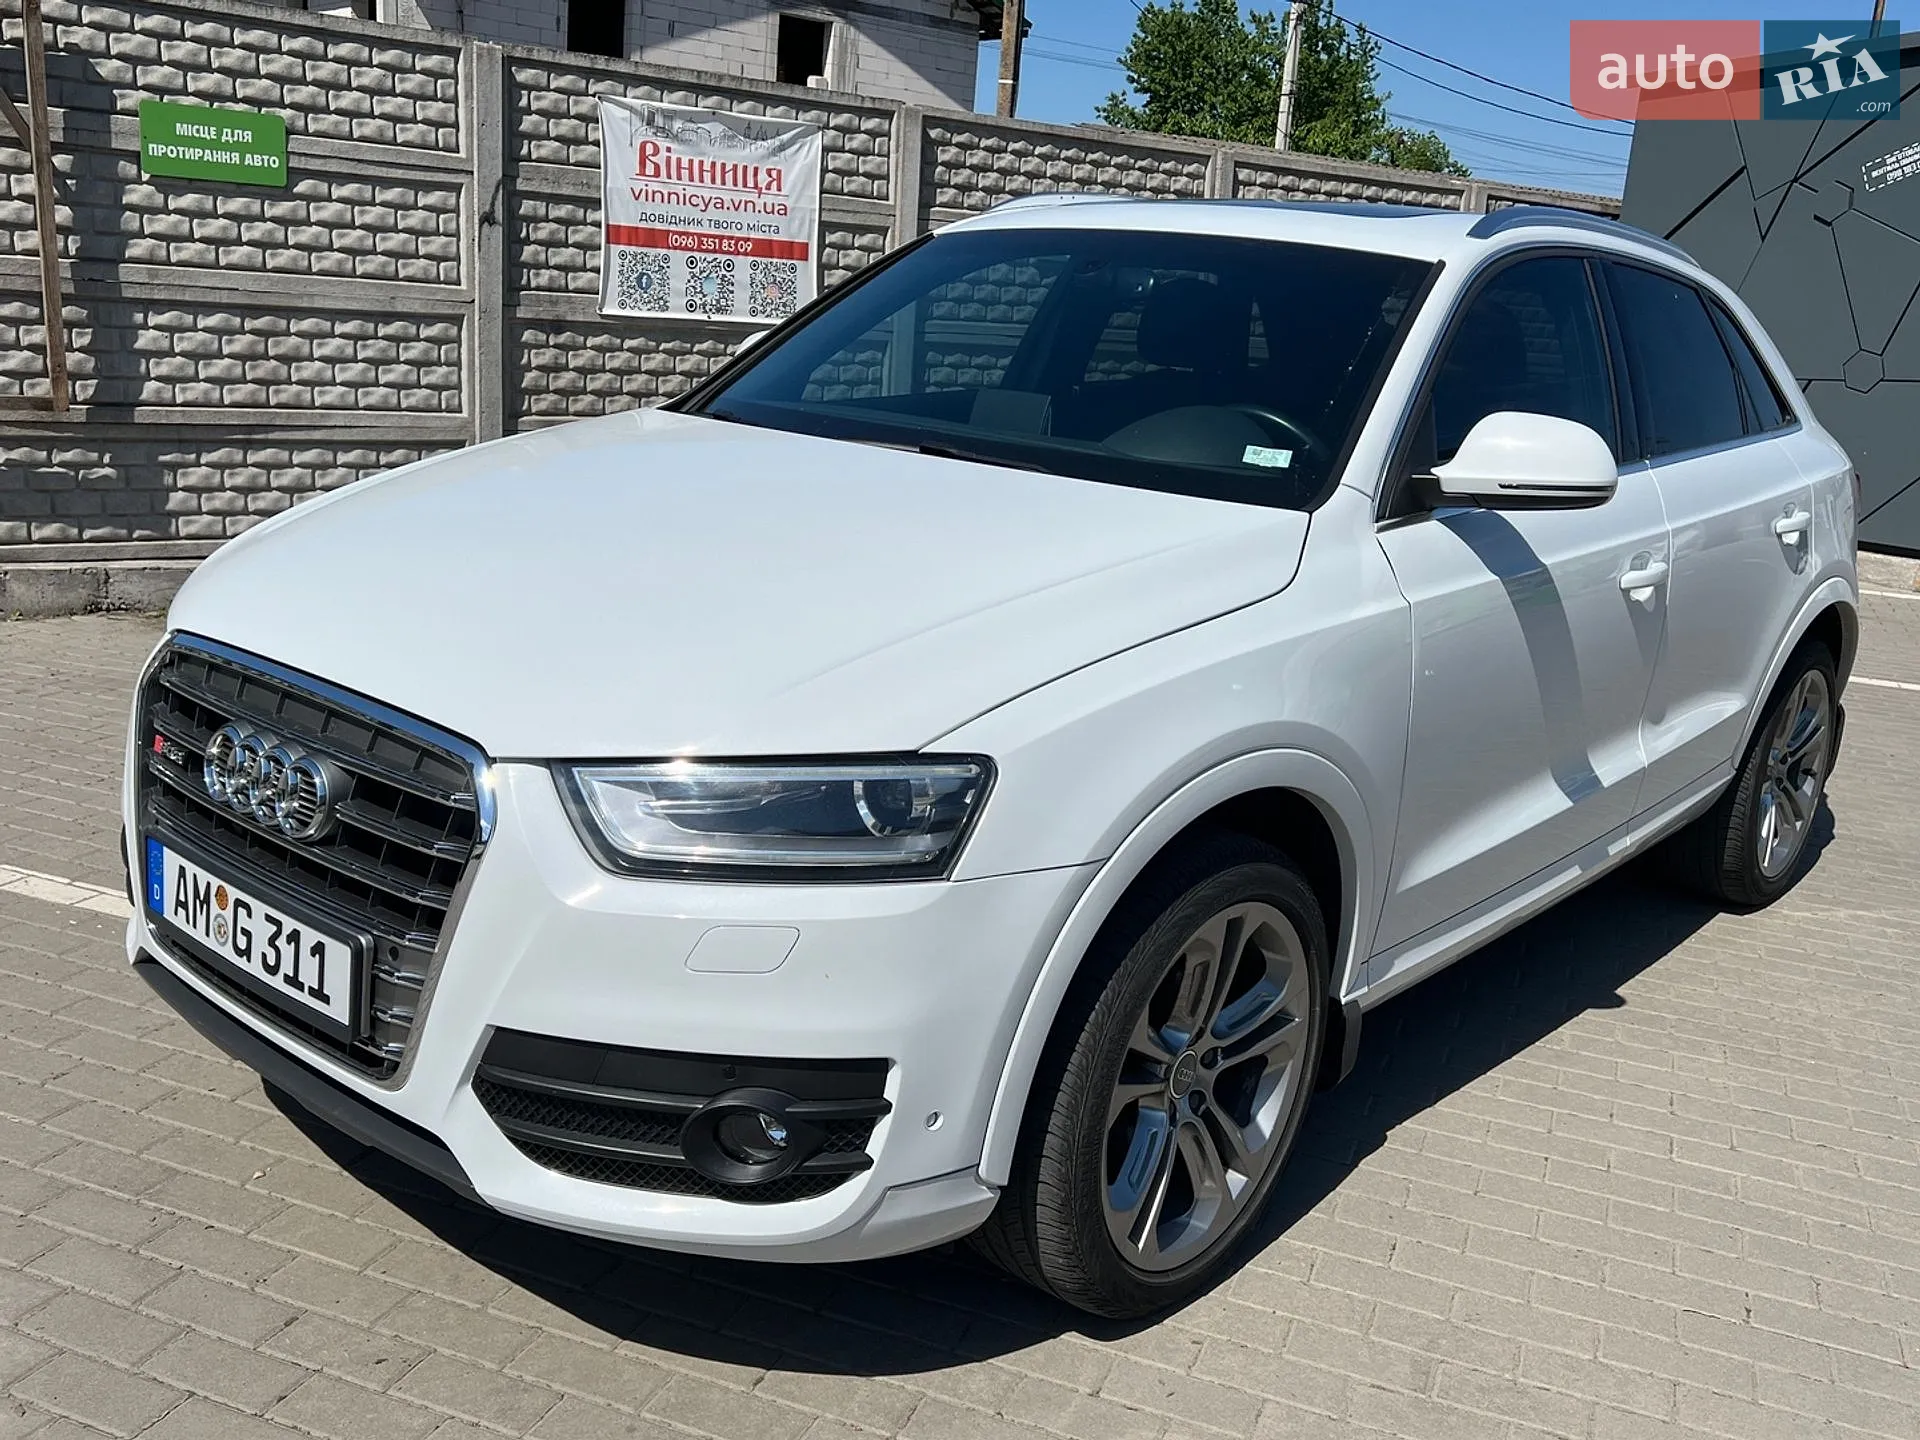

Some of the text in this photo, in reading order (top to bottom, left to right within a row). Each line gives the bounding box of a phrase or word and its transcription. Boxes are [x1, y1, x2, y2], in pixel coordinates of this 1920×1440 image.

[175, 122, 252, 144] МІСЦЕ ДЛЯ
[148, 143, 280, 169] ПРОТИРАННЯ АВТО
[635, 140, 783, 198] Вінниця
[630, 184, 788, 217] vinnicya.vn.ua
[638, 211, 780, 235] довідник твого міста
[668, 232, 753, 253] (096) 351 83 09
[153, 883, 160, 900] D
[174, 864, 331, 1006] AM G 311
